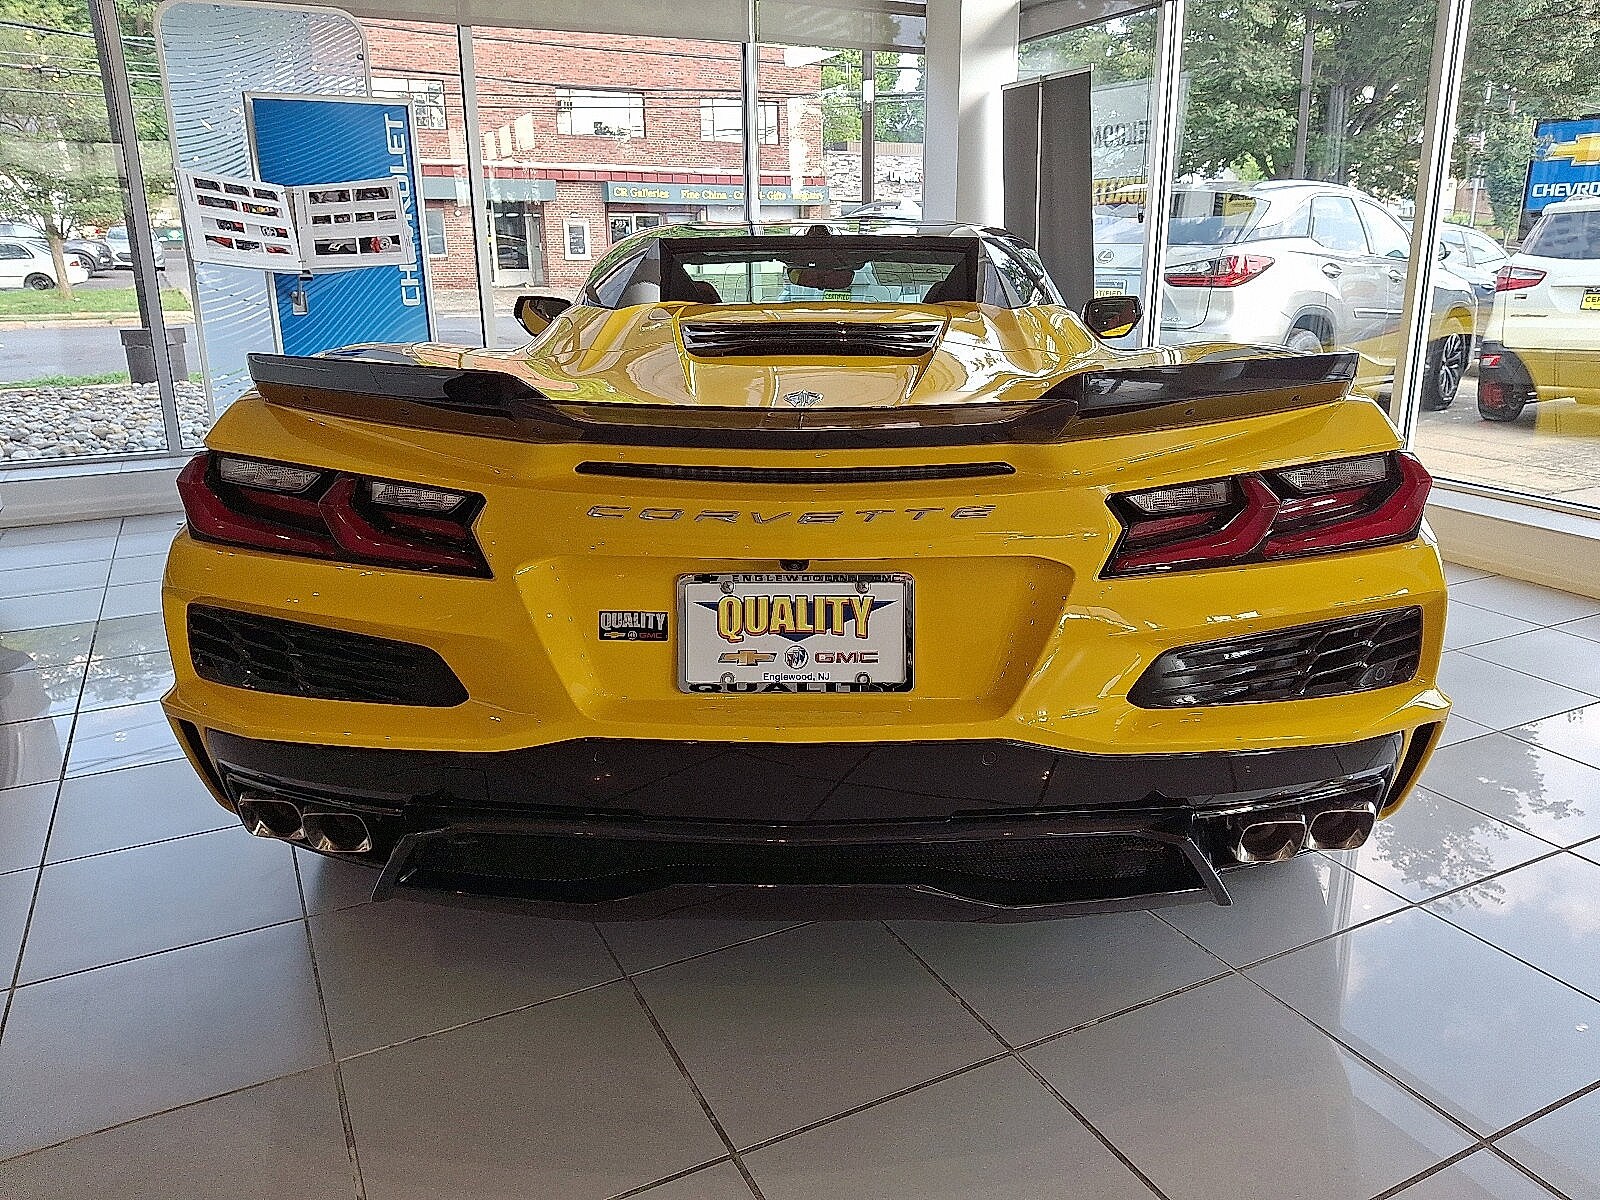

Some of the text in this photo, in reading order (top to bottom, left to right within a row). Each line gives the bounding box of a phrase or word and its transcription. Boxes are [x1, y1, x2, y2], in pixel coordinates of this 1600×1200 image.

[630, 187, 670, 199] Galleries
[680, 190, 701, 200] Fine
[702, 190, 728, 201] China
[384, 113, 421, 308] CHOLET
[586, 503, 997, 524] CORVETTE
[600, 612, 665, 630] QUALITY
[717, 595, 875, 644] QUALITY
[639, 632, 663, 640] GMC
[814, 650, 879, 664] GMC
[763, 672, 830, 683] Englewood, NJ
